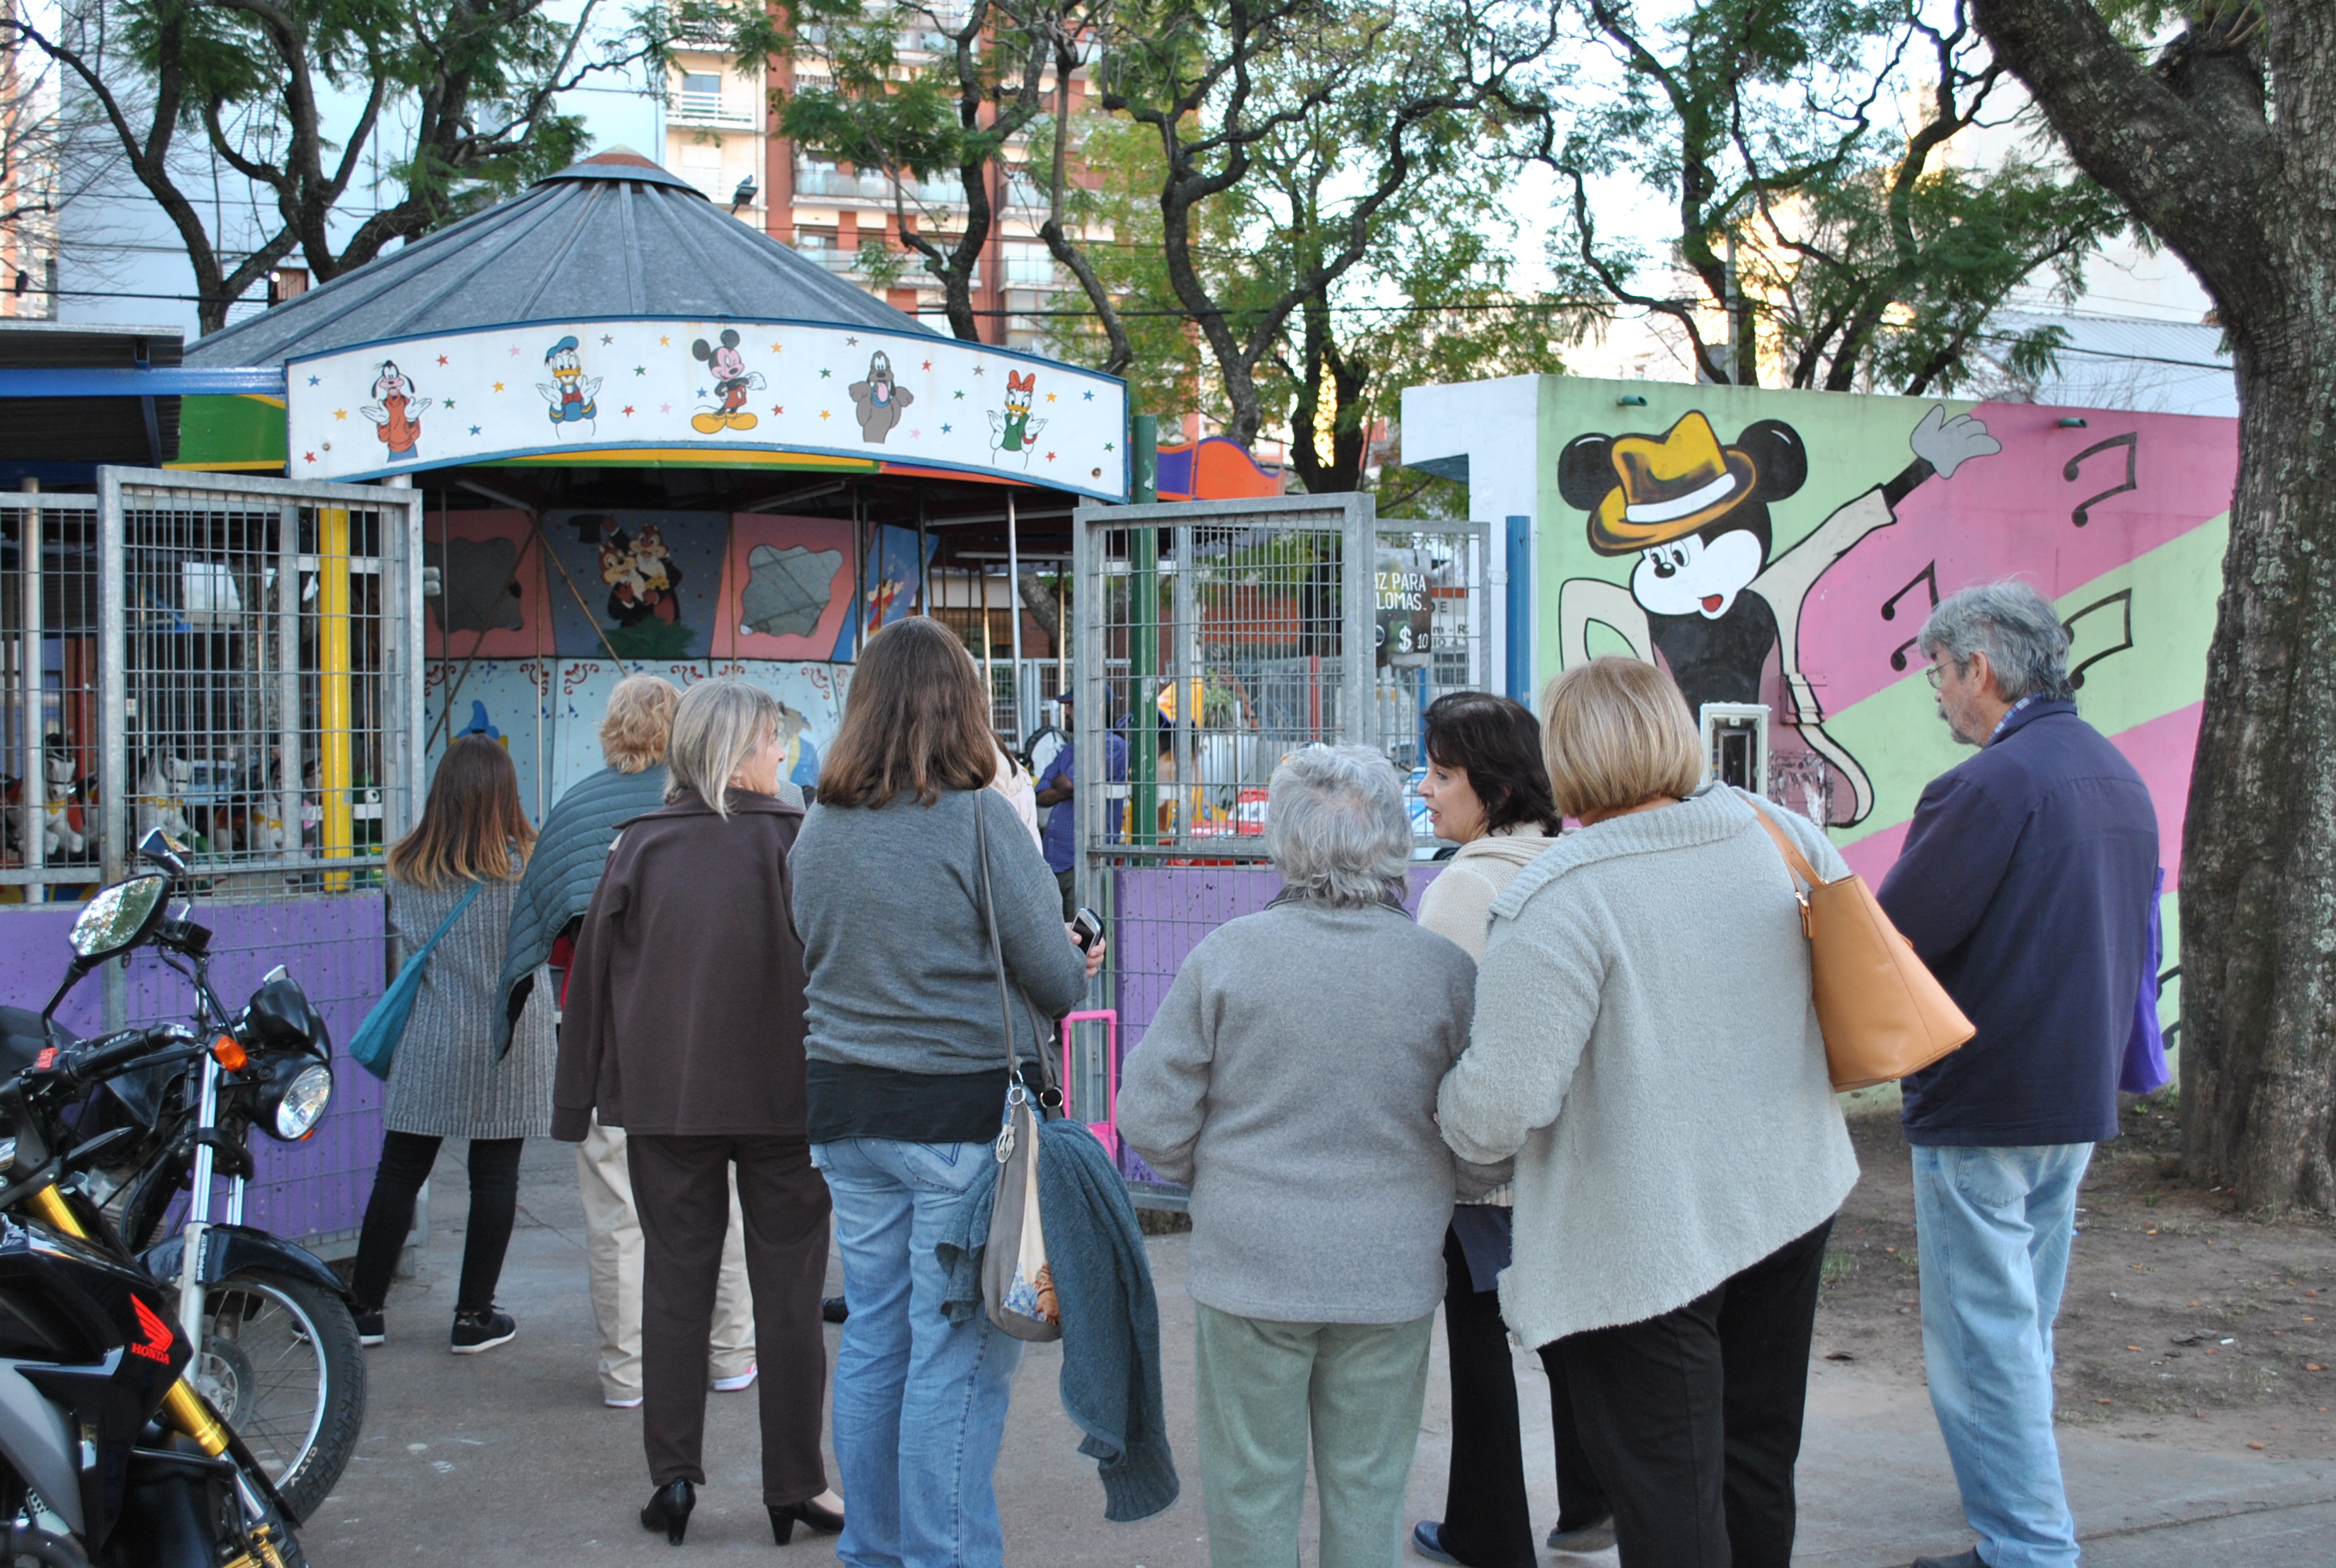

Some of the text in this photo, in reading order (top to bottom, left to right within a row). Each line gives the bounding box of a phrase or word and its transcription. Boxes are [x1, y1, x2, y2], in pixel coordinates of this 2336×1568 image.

[1391, 572, 1427, 592] PARA
[1416, 632, 1429, 650] 10
[131, 1342, 170, 1365] HONDA
[290, 1445, 319, 1487] CITY
